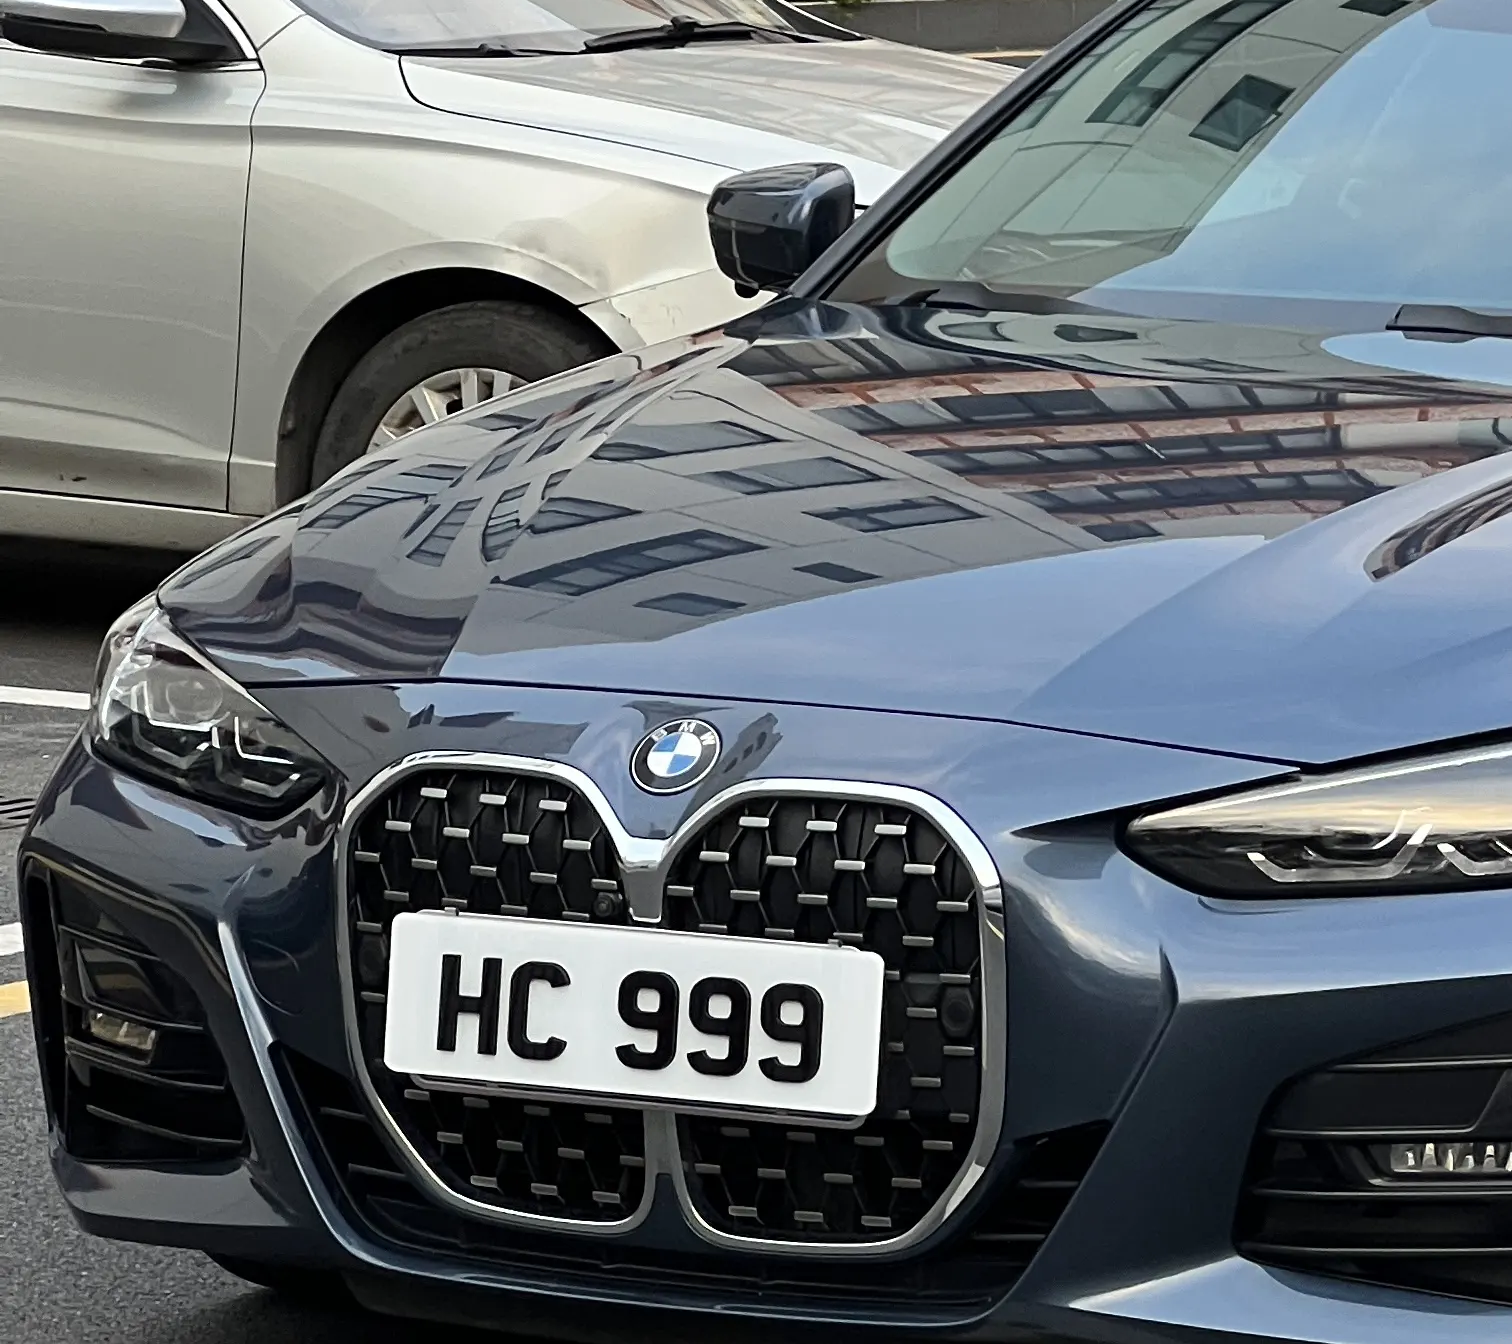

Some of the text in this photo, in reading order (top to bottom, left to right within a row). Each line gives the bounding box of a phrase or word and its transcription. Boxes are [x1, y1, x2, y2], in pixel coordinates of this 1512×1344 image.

[651, 721, 717, 746] BMW
[436, 954, 824, 1084] HC 999
